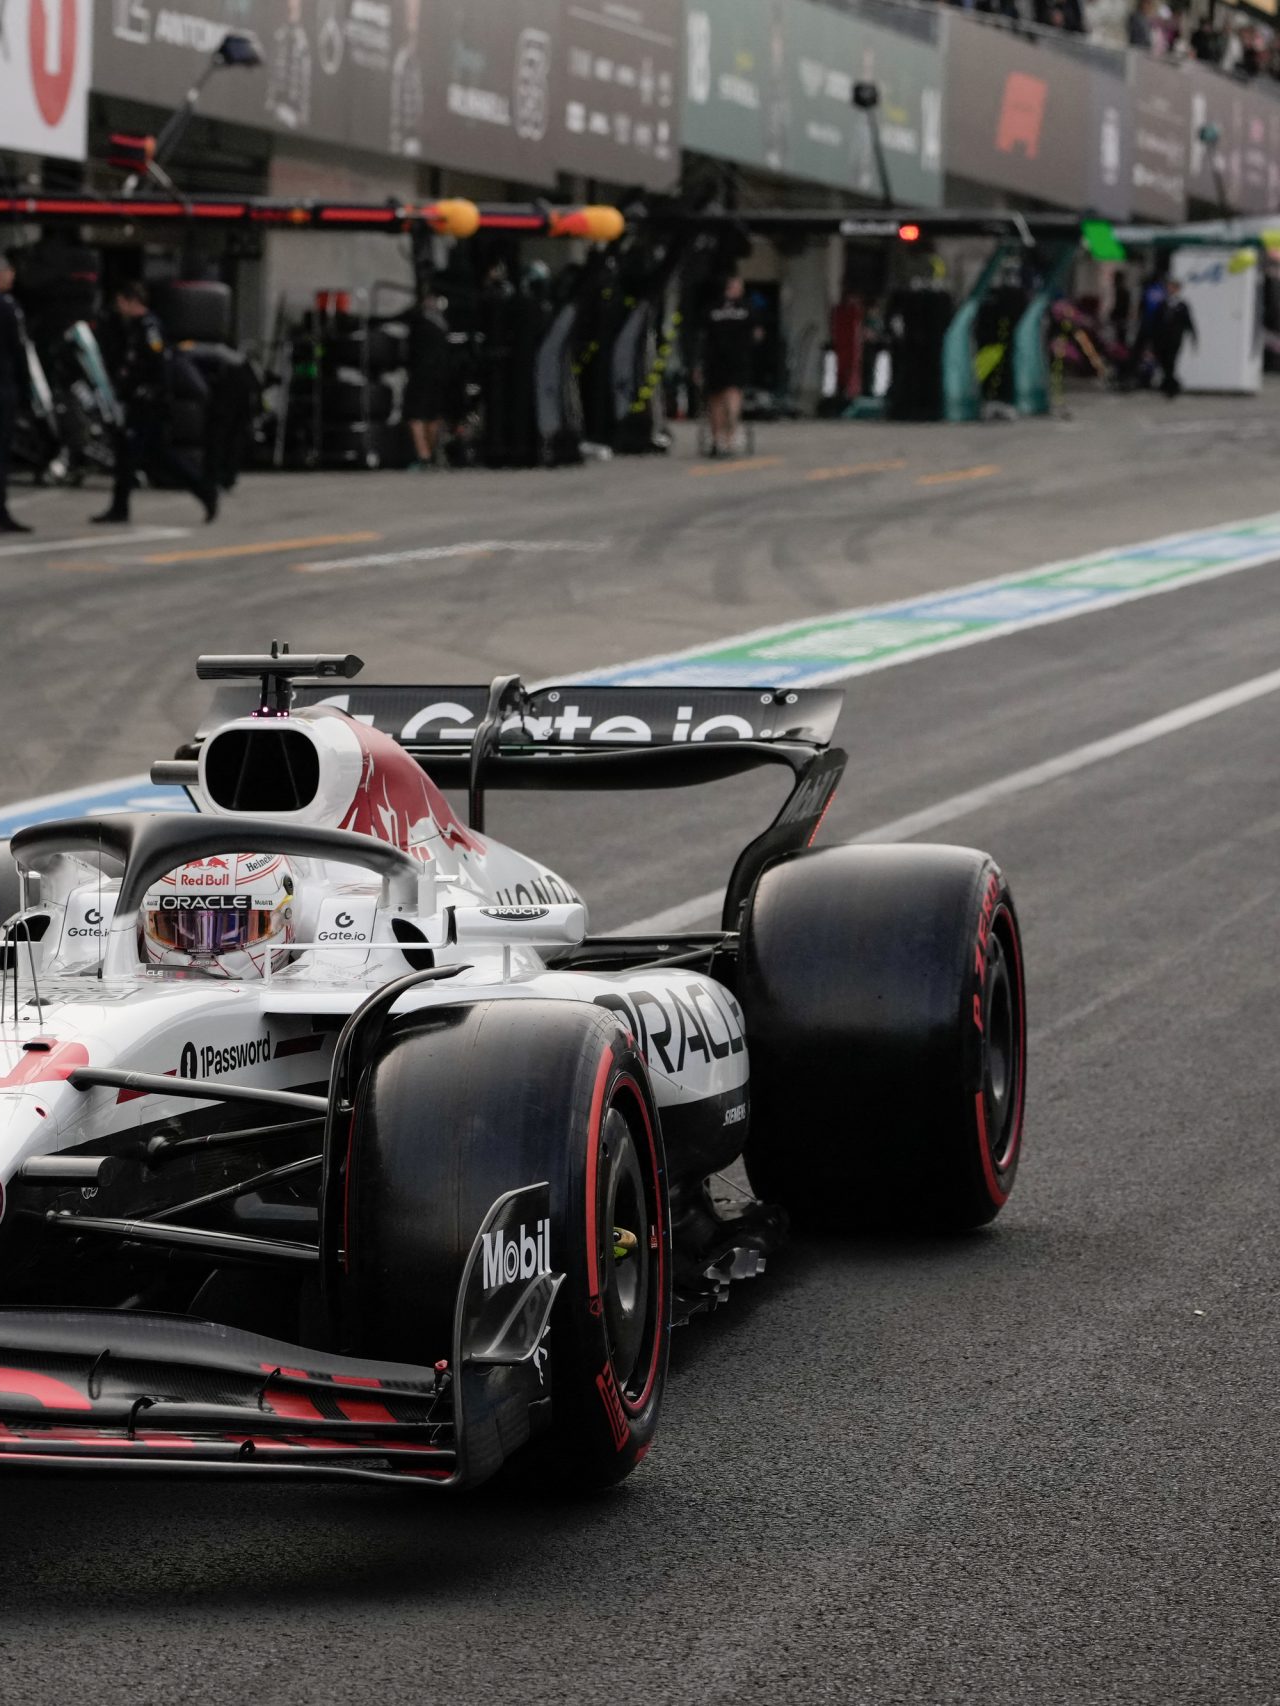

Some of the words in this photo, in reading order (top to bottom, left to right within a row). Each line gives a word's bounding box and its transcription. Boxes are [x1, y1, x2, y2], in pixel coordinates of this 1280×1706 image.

[181, 875, 203, 886] Red
[205, 875, 229, 886] Bull
[162, 896, 247, 909] ORACLE
[67, 927, 110, 937] Gate.i
[318, 931, 366, 941] Gate.io
[200, 1031, 270, 1079] 1Password
[482, 1218, 552, 1290] Mobil
